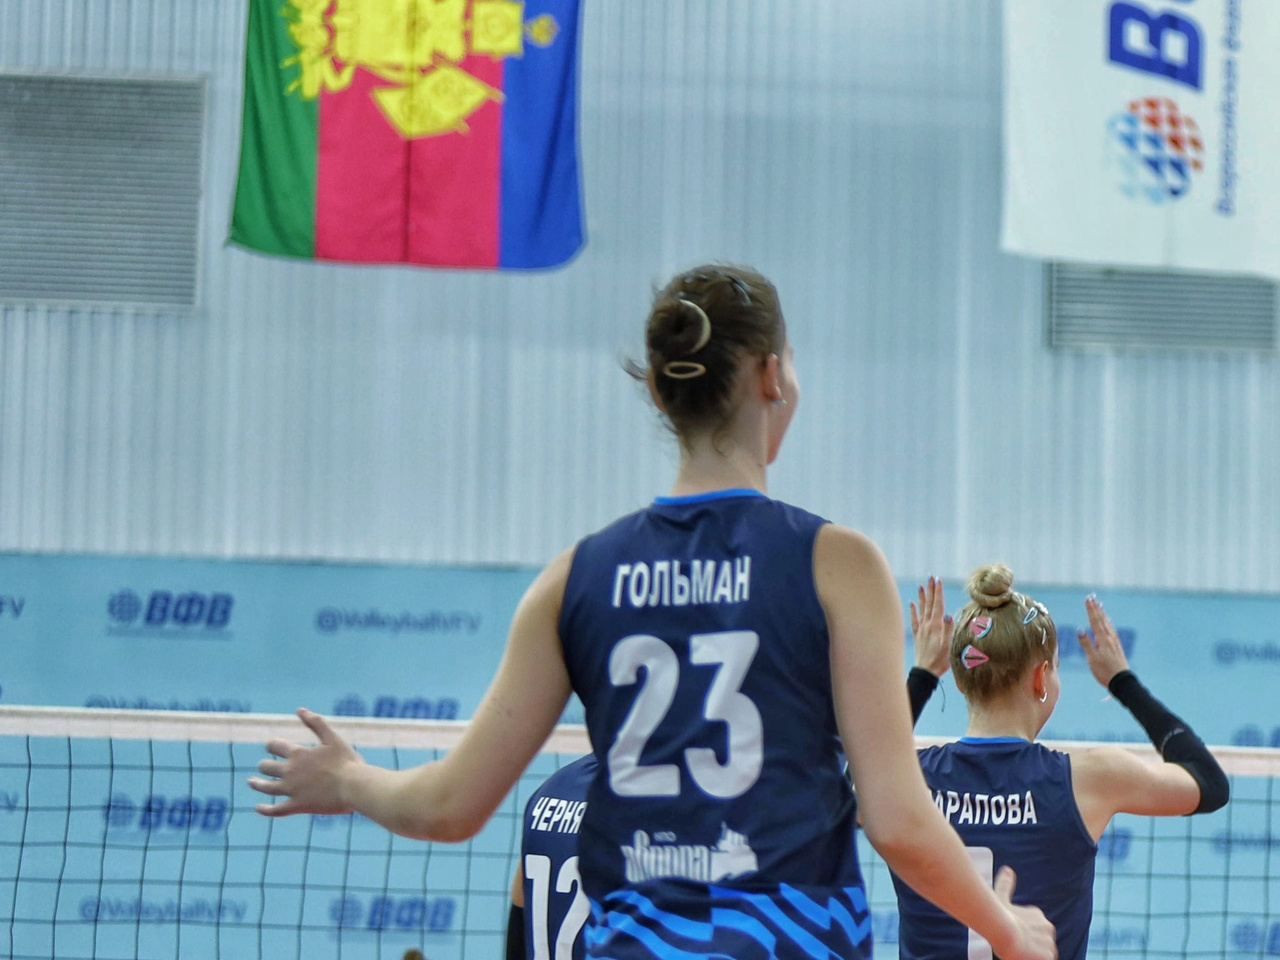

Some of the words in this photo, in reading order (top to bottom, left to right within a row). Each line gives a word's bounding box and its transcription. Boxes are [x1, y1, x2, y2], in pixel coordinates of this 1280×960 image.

[612, 556, 751, 608] ГОЛЬМАН
[144, 590, 234, 629] ВФВ
[609, 630, 764, 798] 23
